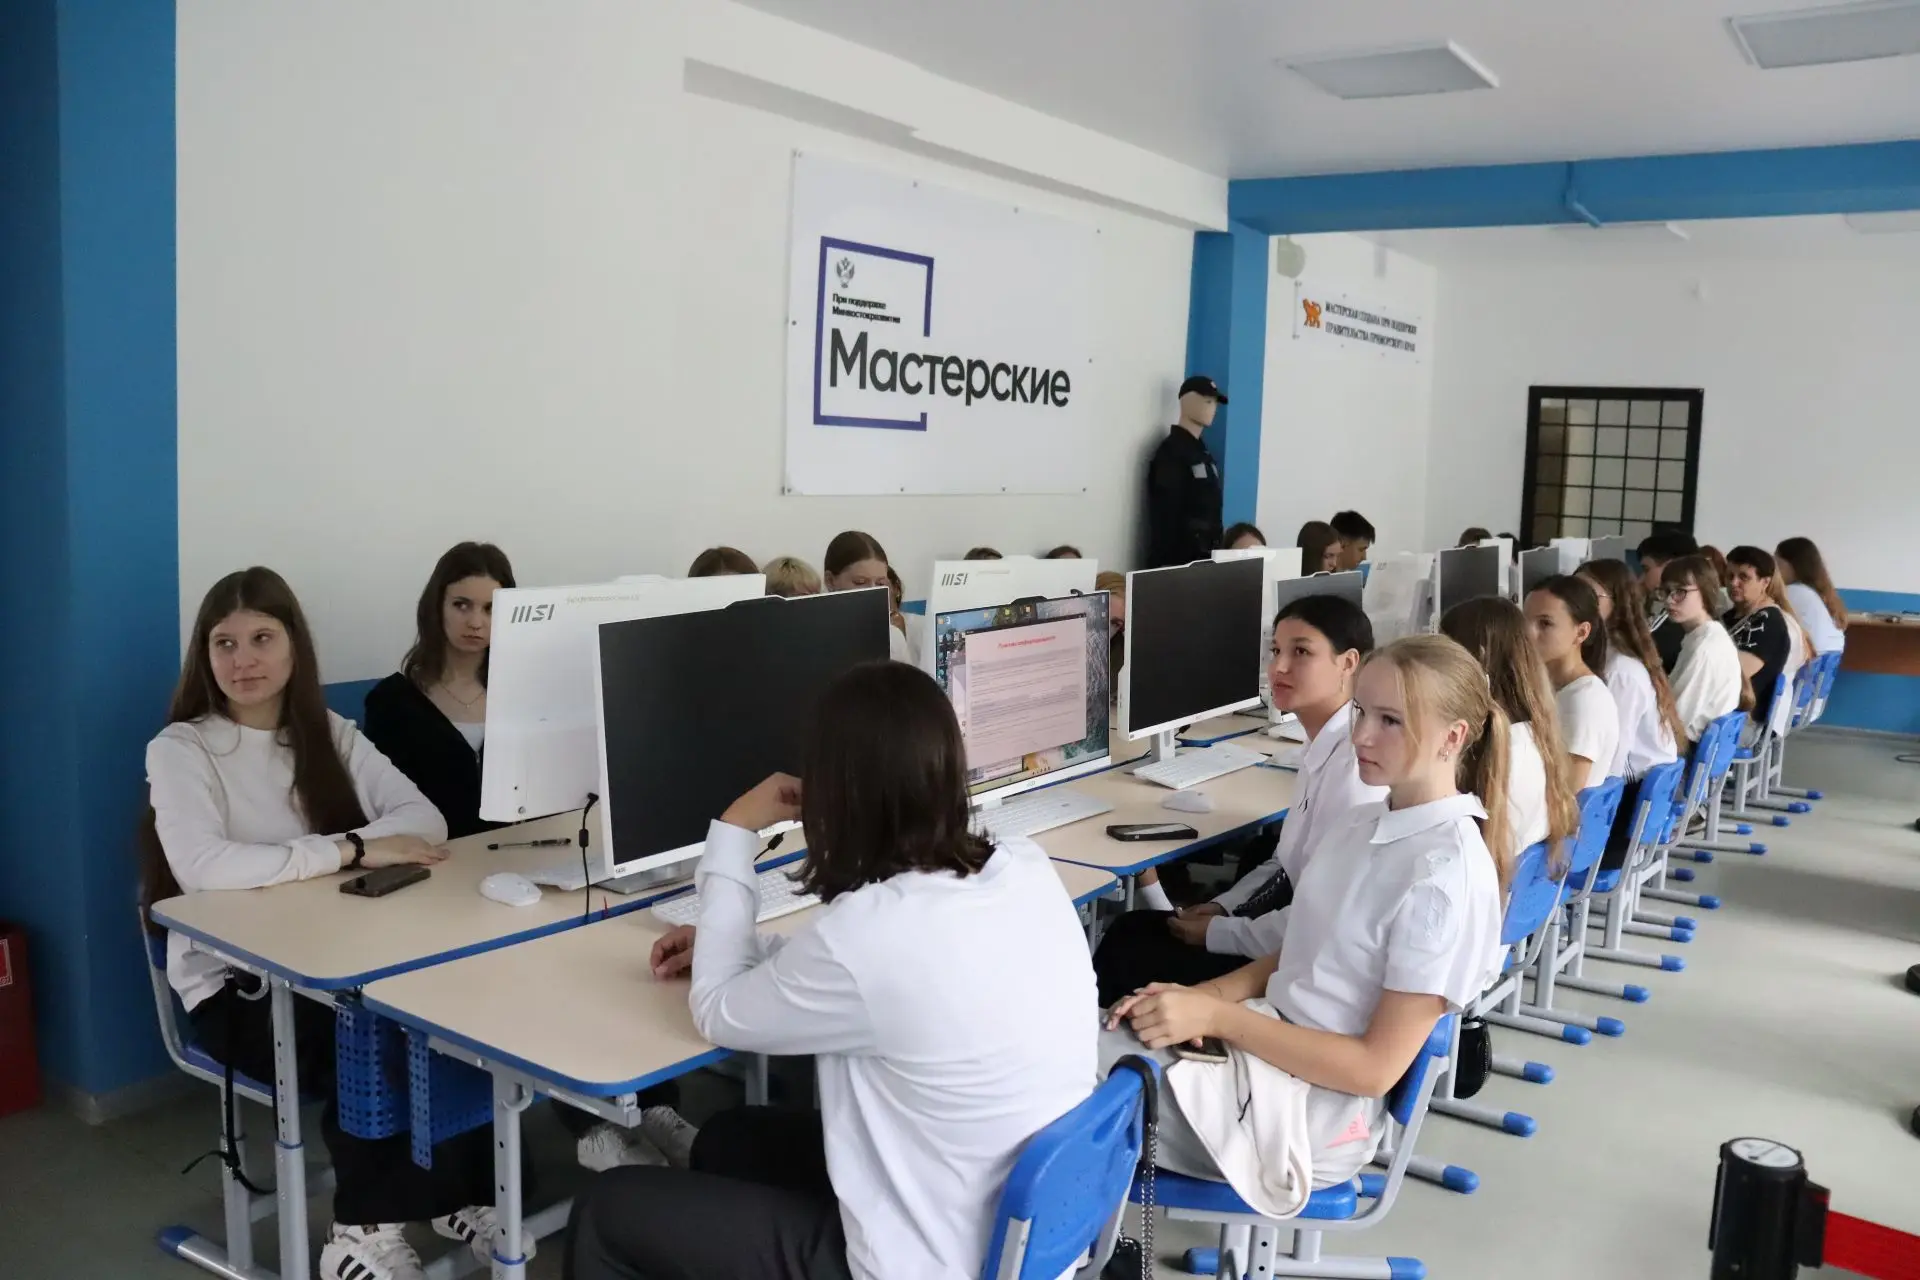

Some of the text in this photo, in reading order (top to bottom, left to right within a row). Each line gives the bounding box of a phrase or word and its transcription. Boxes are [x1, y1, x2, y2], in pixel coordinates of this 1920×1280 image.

[832, 293, 847, 304] При
[830, 328, 1071, 407] Мастерские
[941, 572, 969, 586] MSI
[511, 603, 555, 624] MSI
